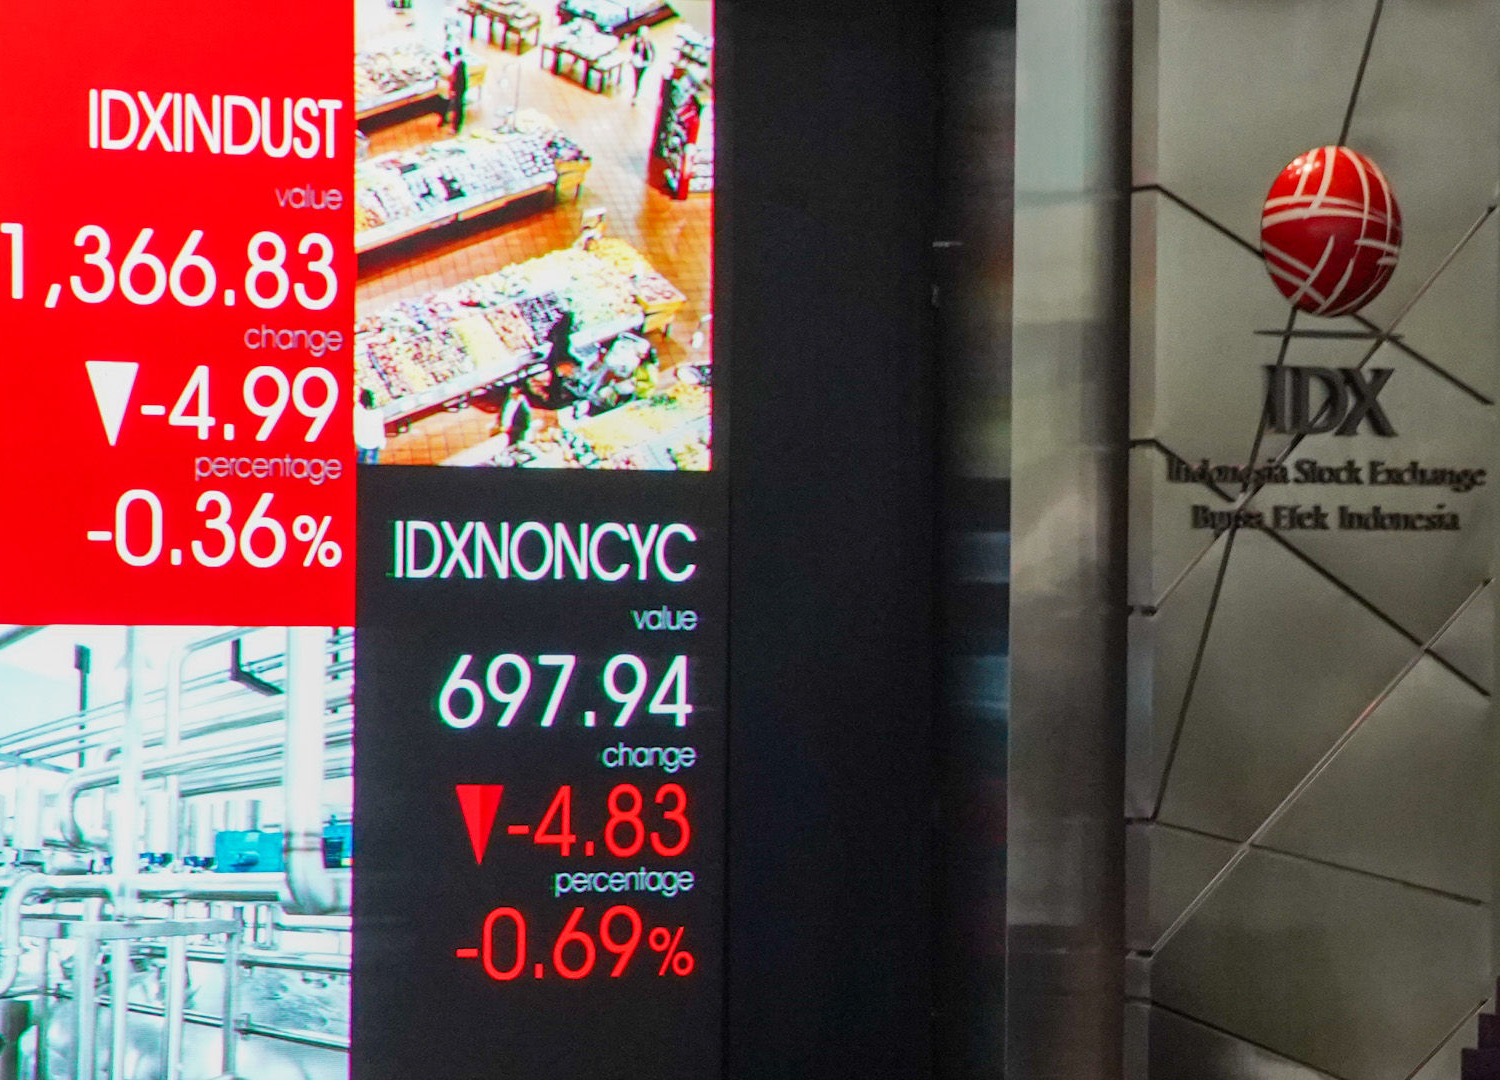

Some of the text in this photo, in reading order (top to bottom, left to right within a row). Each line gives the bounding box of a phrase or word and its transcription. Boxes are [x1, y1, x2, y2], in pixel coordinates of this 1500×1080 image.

[88, 89, 342, 158] IDXINDUST
[275, 184, 343, 210] value
[0, 222, 338, 310] 1,366.83
[244, 324, 343, 357] change
[140, 364, 339, 443] -4.99
[1262, 365, 1398, 437] IDX
[194, 455, 342, 485] percentage
[1166, 453, 1486, 492] Indonesia Stock Exchange
[87, 488, 342, 568] -0.36%
[1273, 504, 1329, 530] Efek
[1338, 502, 1460, 530] Indonesia
[394, 521, 697, 582] IDXNONCYC
[632, 605, 697, 631] value
[438, 653, 693, 729] 697.94
[602, 742, 697, 772] change
[507, 783, 691, 857] -4.83
[555, 868, 694, 897] percentage
[456, 905, 694, 981] -0.69%
